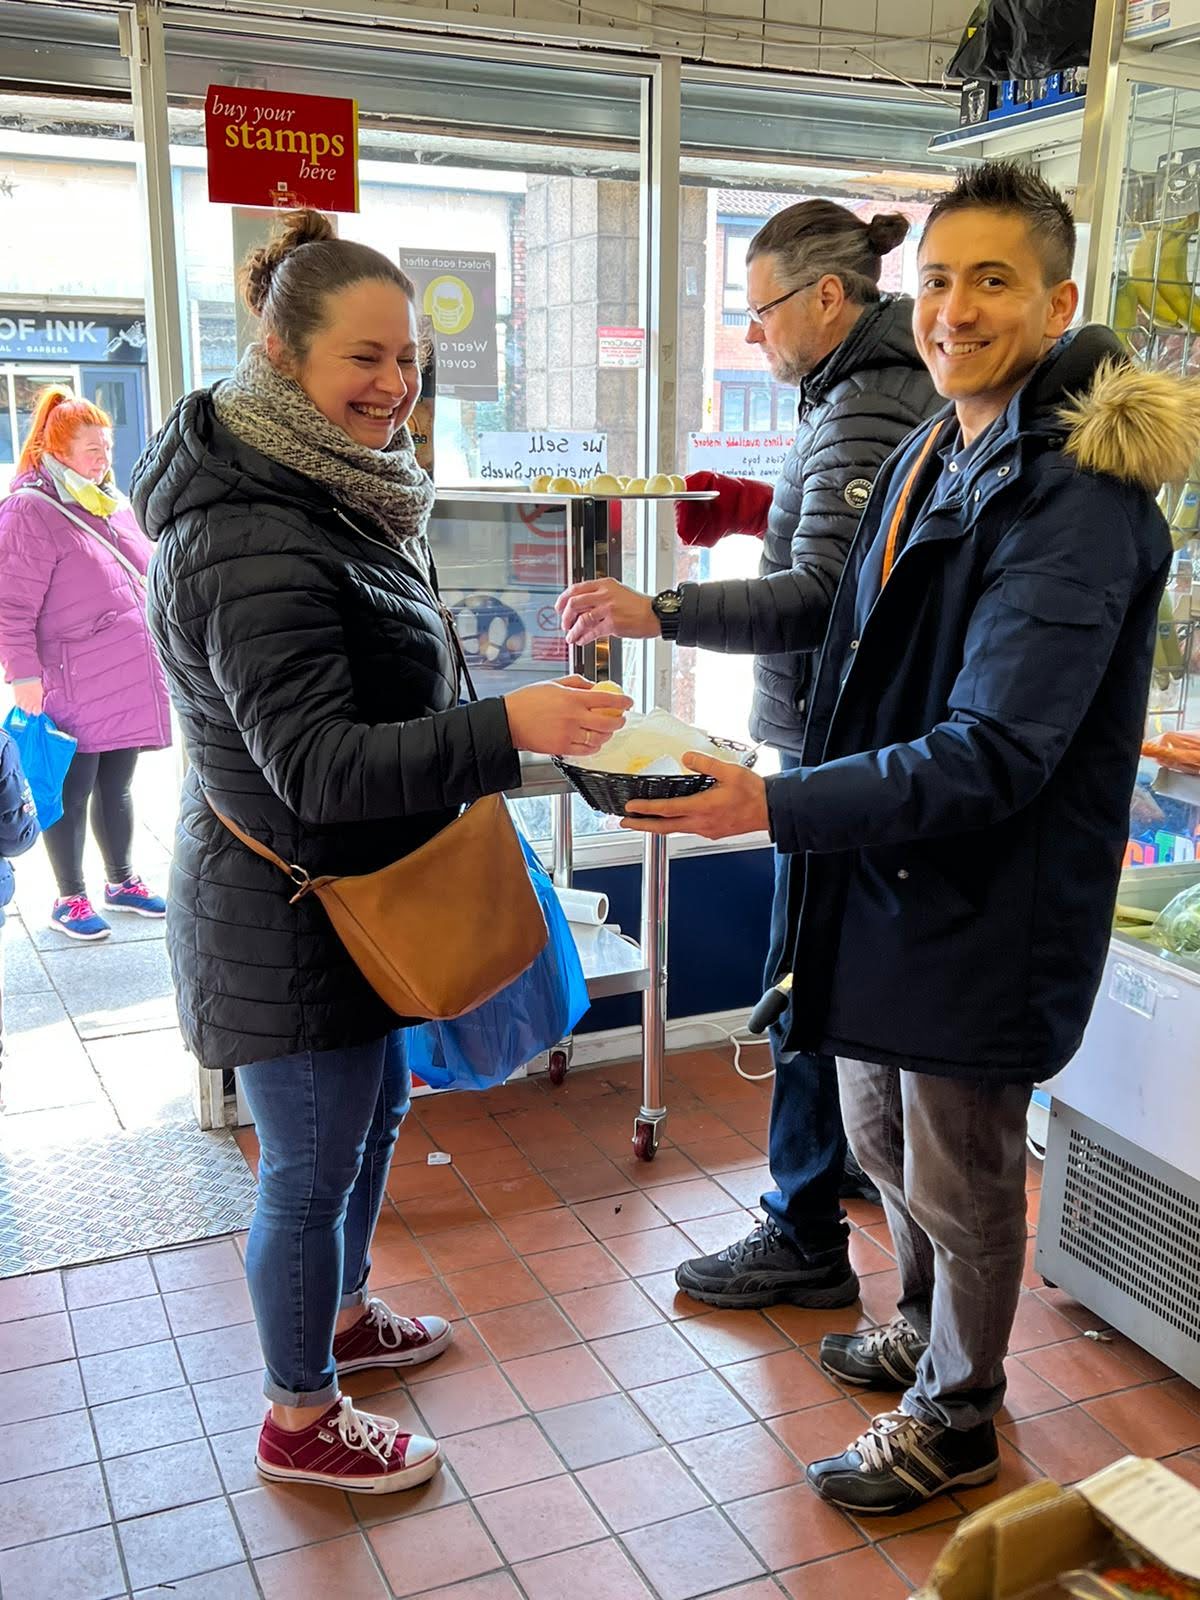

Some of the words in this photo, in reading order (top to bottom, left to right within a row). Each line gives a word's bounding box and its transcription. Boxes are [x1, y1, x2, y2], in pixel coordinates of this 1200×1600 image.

[212, 95, 247, 123] buy
[252, 106, 296, 124] your
[225, 121, 345, 166] stamps
[299, 159, 337, 181] here
[0, 318, 35, 341] OF
[46, 320, 97, 343] INK
